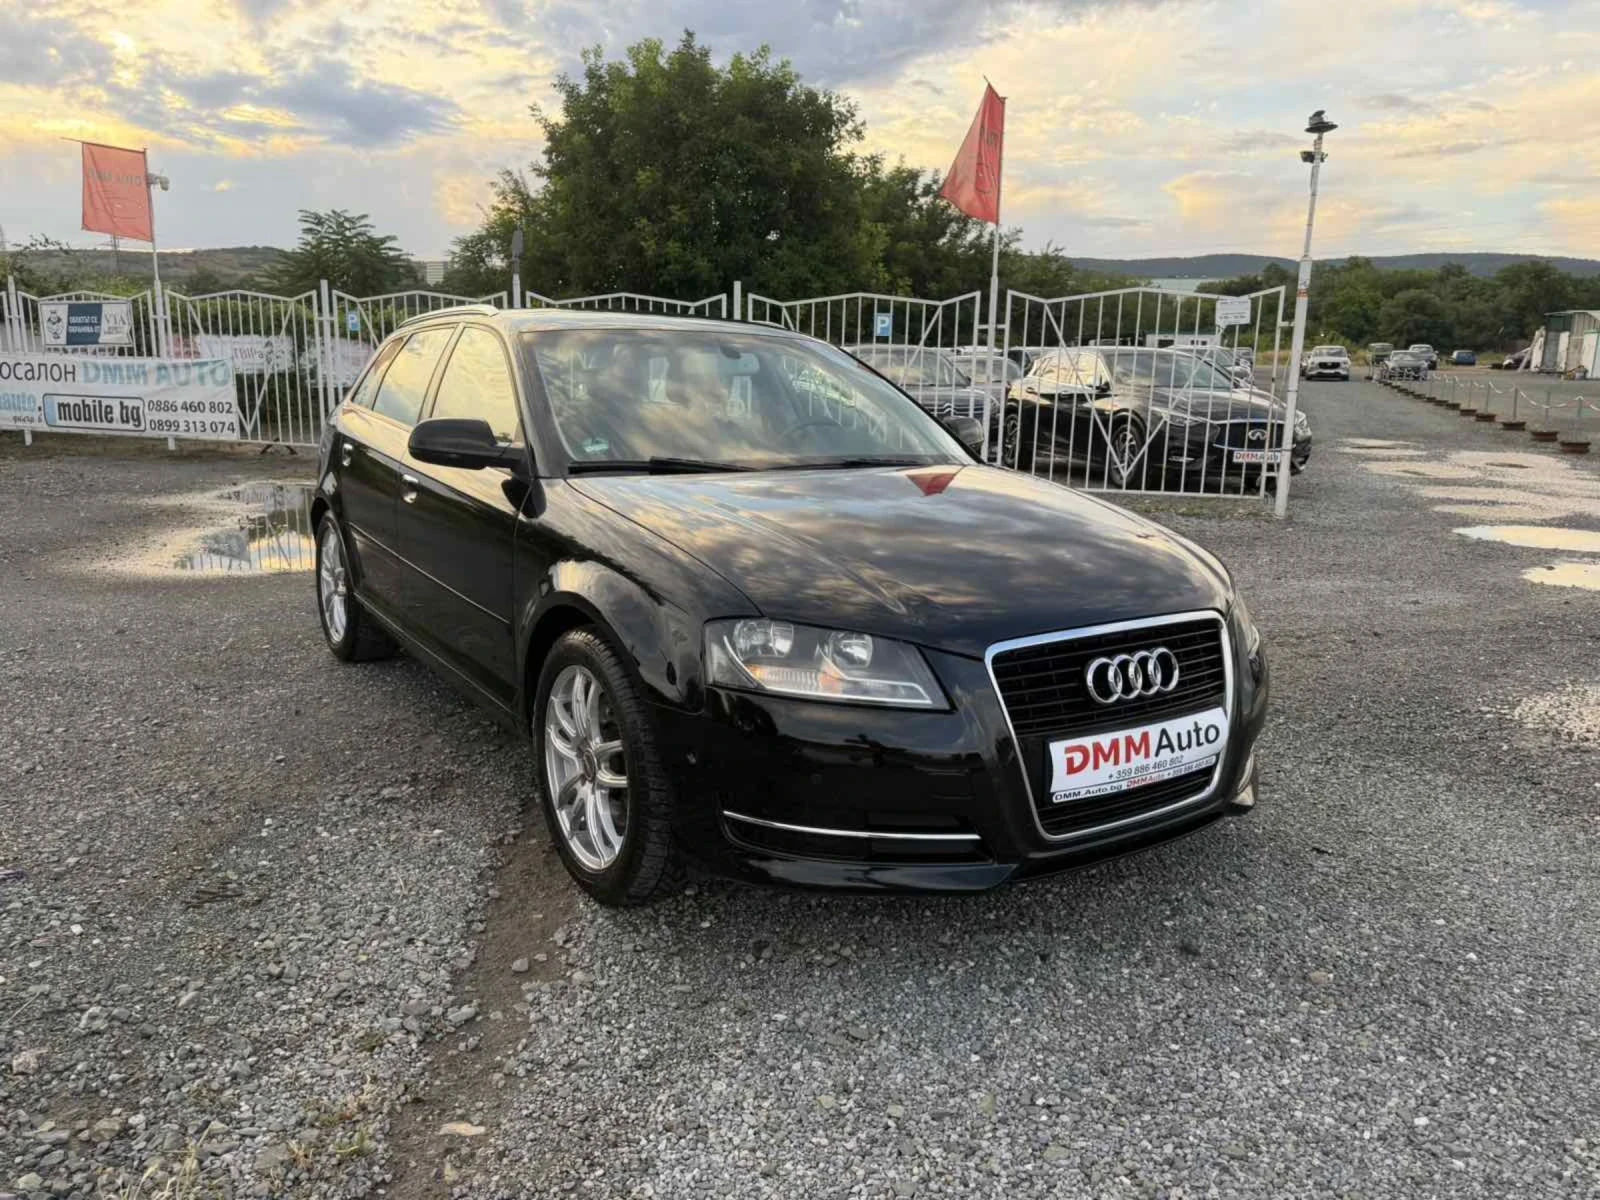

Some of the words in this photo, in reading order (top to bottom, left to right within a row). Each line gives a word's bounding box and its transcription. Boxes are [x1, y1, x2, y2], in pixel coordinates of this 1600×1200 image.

[877, 316, 890, 335] P
[82, 361, 148, 385] DMM
[156, 360, 231, 387] AUTO
[57, 399, 142, 428] mobile.bg
[147, 400, 178, 413] 0886
[181, 401, 206, 414] 460
[208, 401, 233, 414] 802
[149, 419, 180, 432] 0899
[183, 420, 207, 433] 313
[210, 421, 236, 434] 074
[1116, 767, 1133, 779] 359
[1134, 763, 1151, 775] 886
[1152, 760, 1168, 771] 460
[1169, 755, 1184, 766] 802
